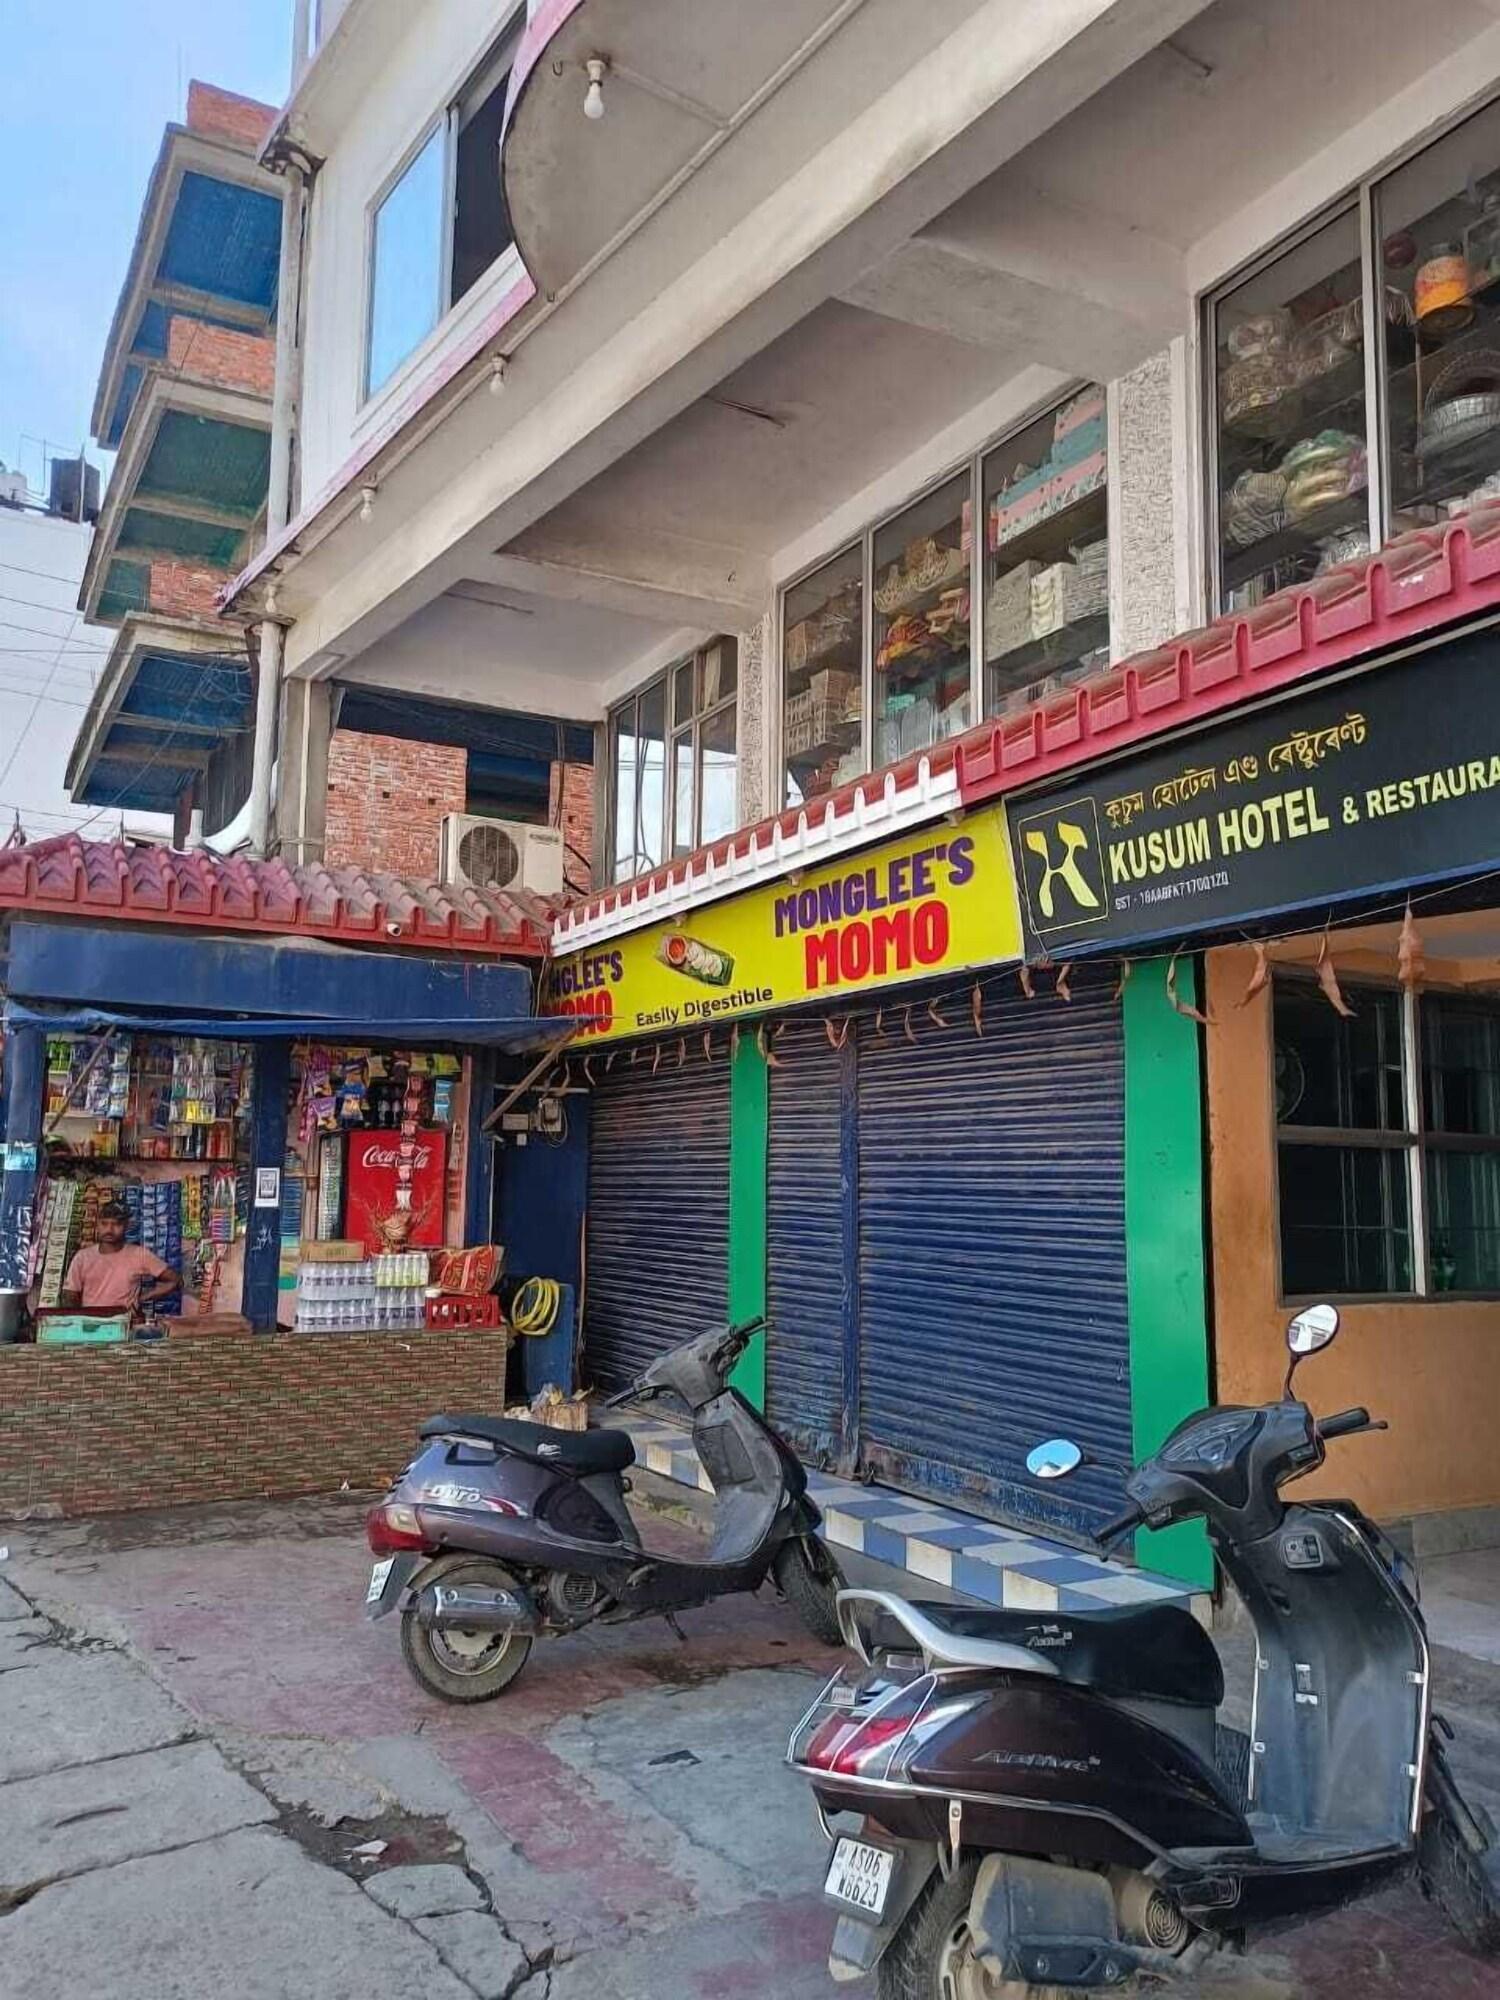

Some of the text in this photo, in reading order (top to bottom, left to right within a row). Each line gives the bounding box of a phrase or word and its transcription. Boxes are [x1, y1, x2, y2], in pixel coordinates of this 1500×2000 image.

[1108, 755, 1500, 885] KUSUM HOTEL & RESTAURA
[1151, 767, 1218, 810] হোটেল
[774, 836, 975, 938] MONGLEE'S
[805, 900, 949, 990] MOMO
[636, 987, 773, 1026] Easily Digestible
